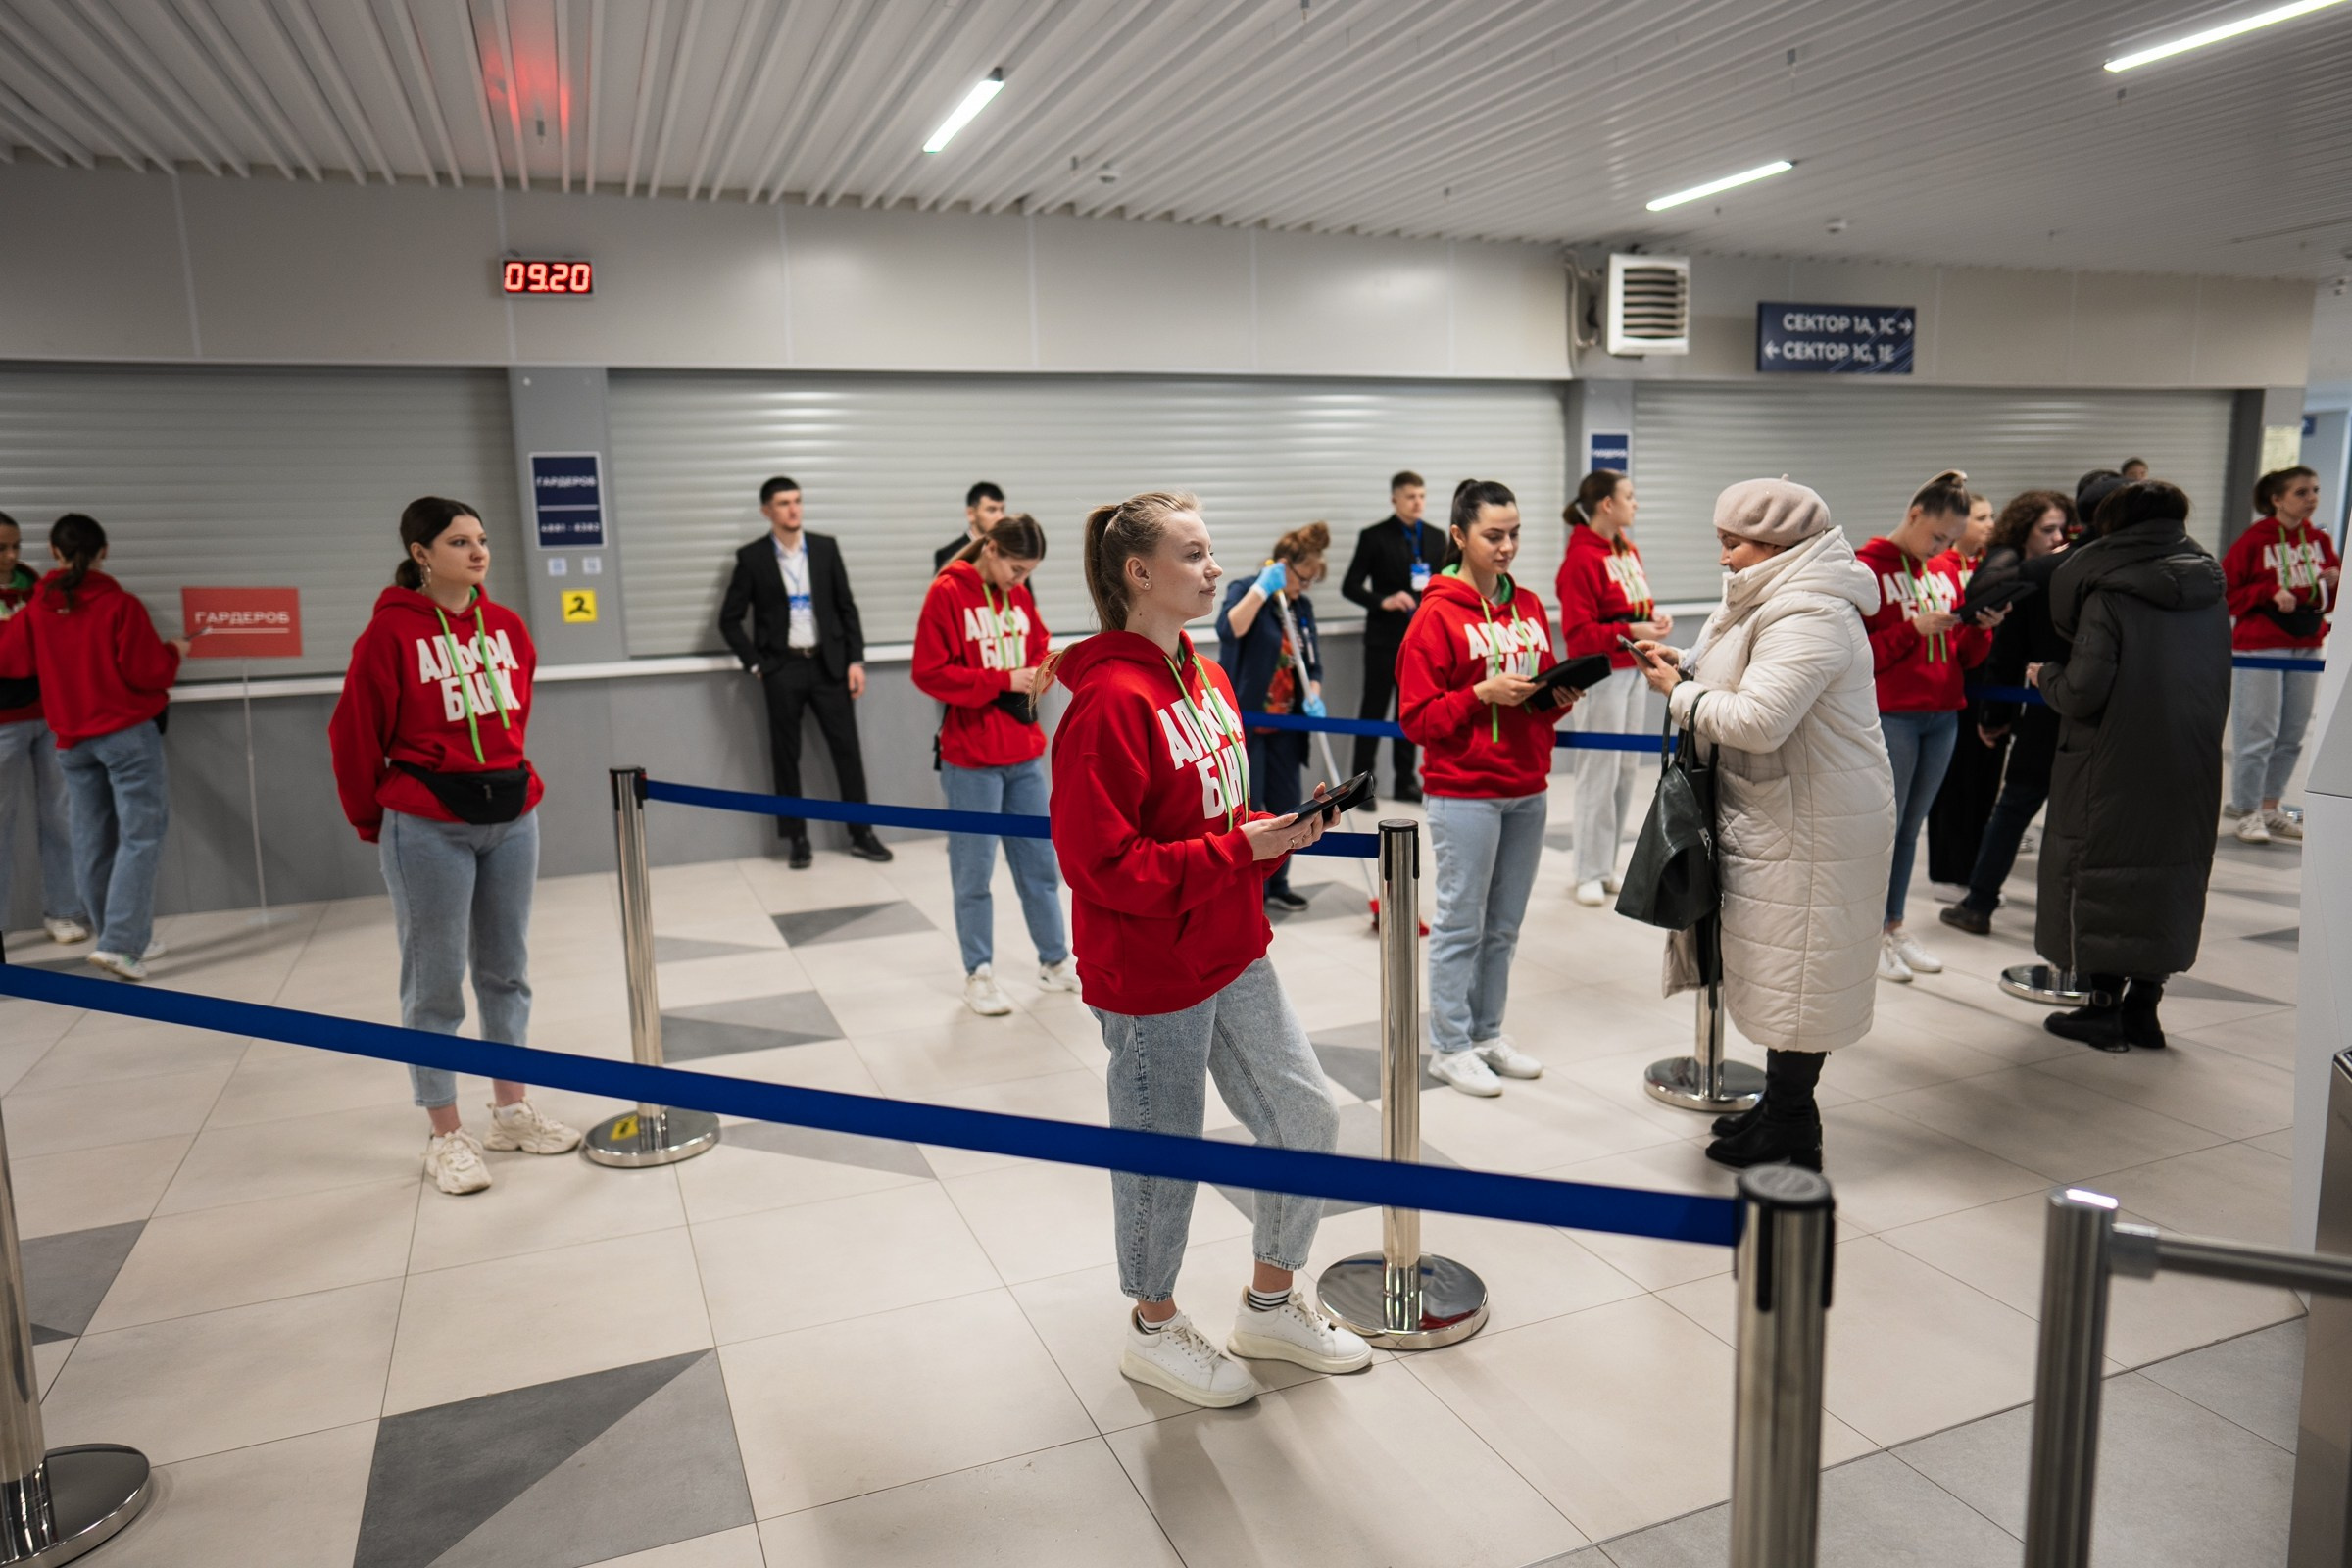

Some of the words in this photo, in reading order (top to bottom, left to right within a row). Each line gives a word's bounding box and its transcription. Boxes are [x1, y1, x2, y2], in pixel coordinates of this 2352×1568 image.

[1782, 312, 1851, 334] СЕКТОР
[1782, 340, 1850, 363] СЕКТОР
[194, 611, 290, 626] ГАРДЕРОБ
[416, 629, 520, 684] АЛЬФА
